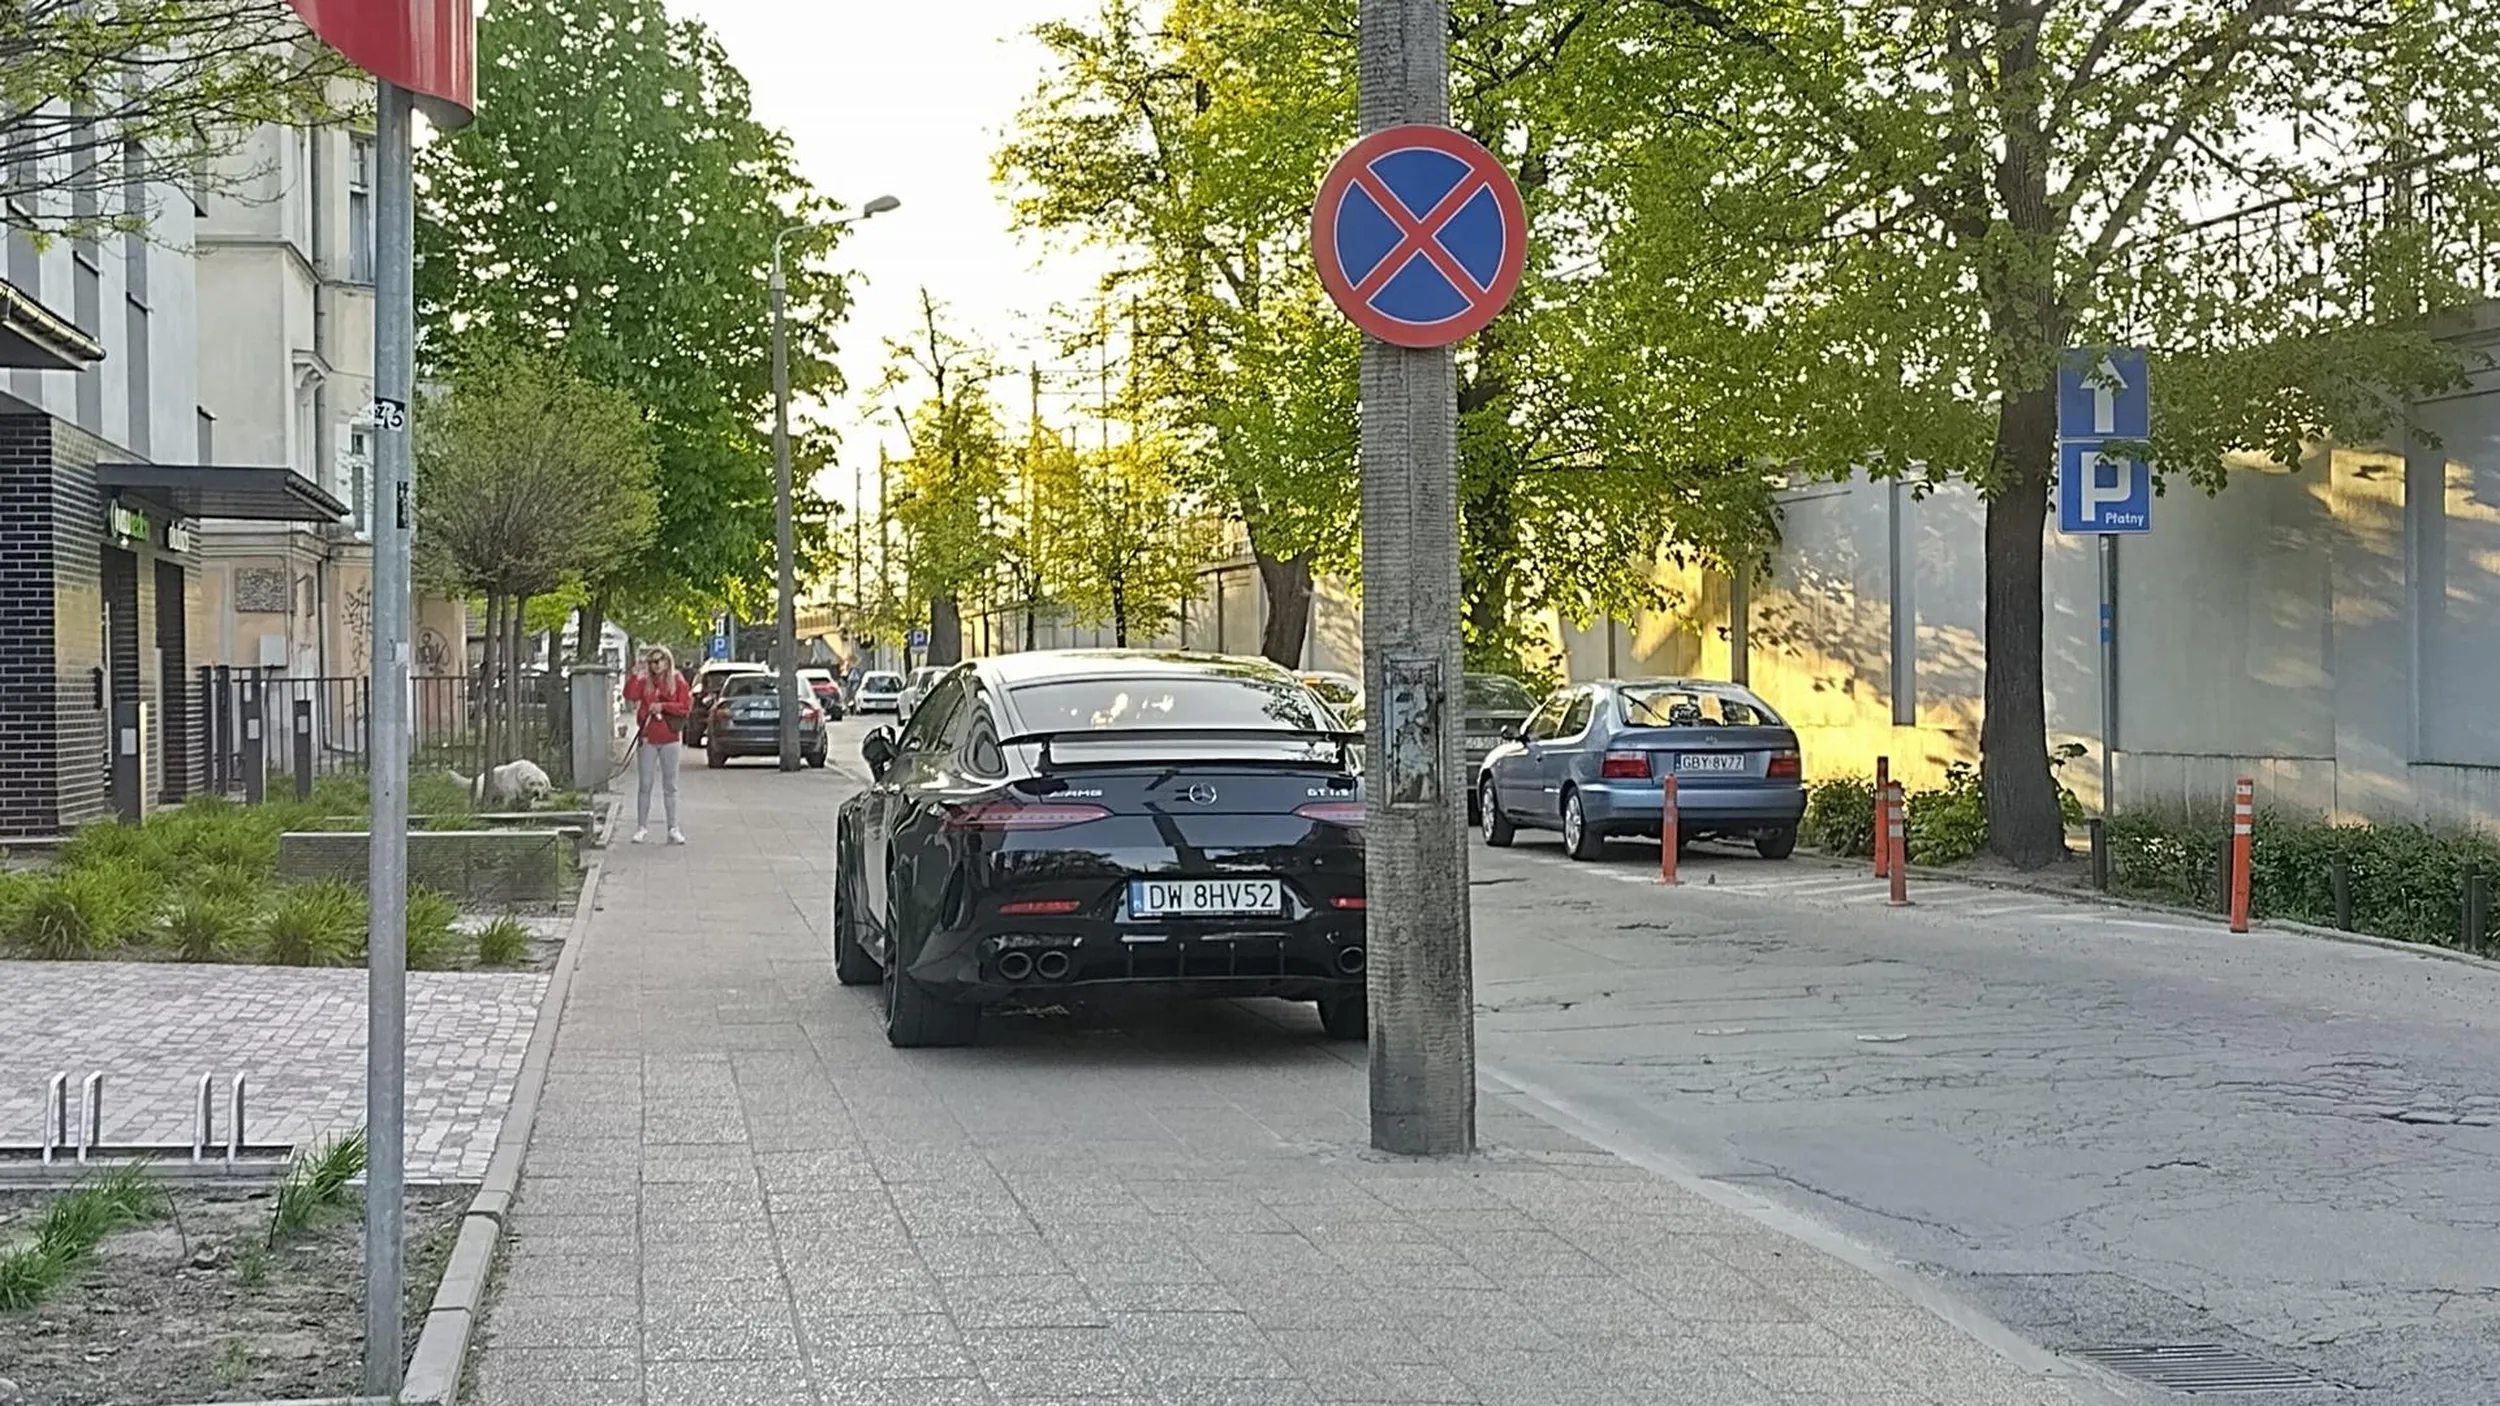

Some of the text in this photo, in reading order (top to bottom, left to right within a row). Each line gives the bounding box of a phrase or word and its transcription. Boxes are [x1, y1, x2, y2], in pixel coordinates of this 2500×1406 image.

[2081, 452, 2131, 521] P
[2105, 511, 2144, 526] Płatny
[714, 638, 725, 652] P
[914, 631, 925, 645] P
[1683, 756, 1742, 769] GBY 8V77
[1150, 884, 1273, 909] DW 8HV52
